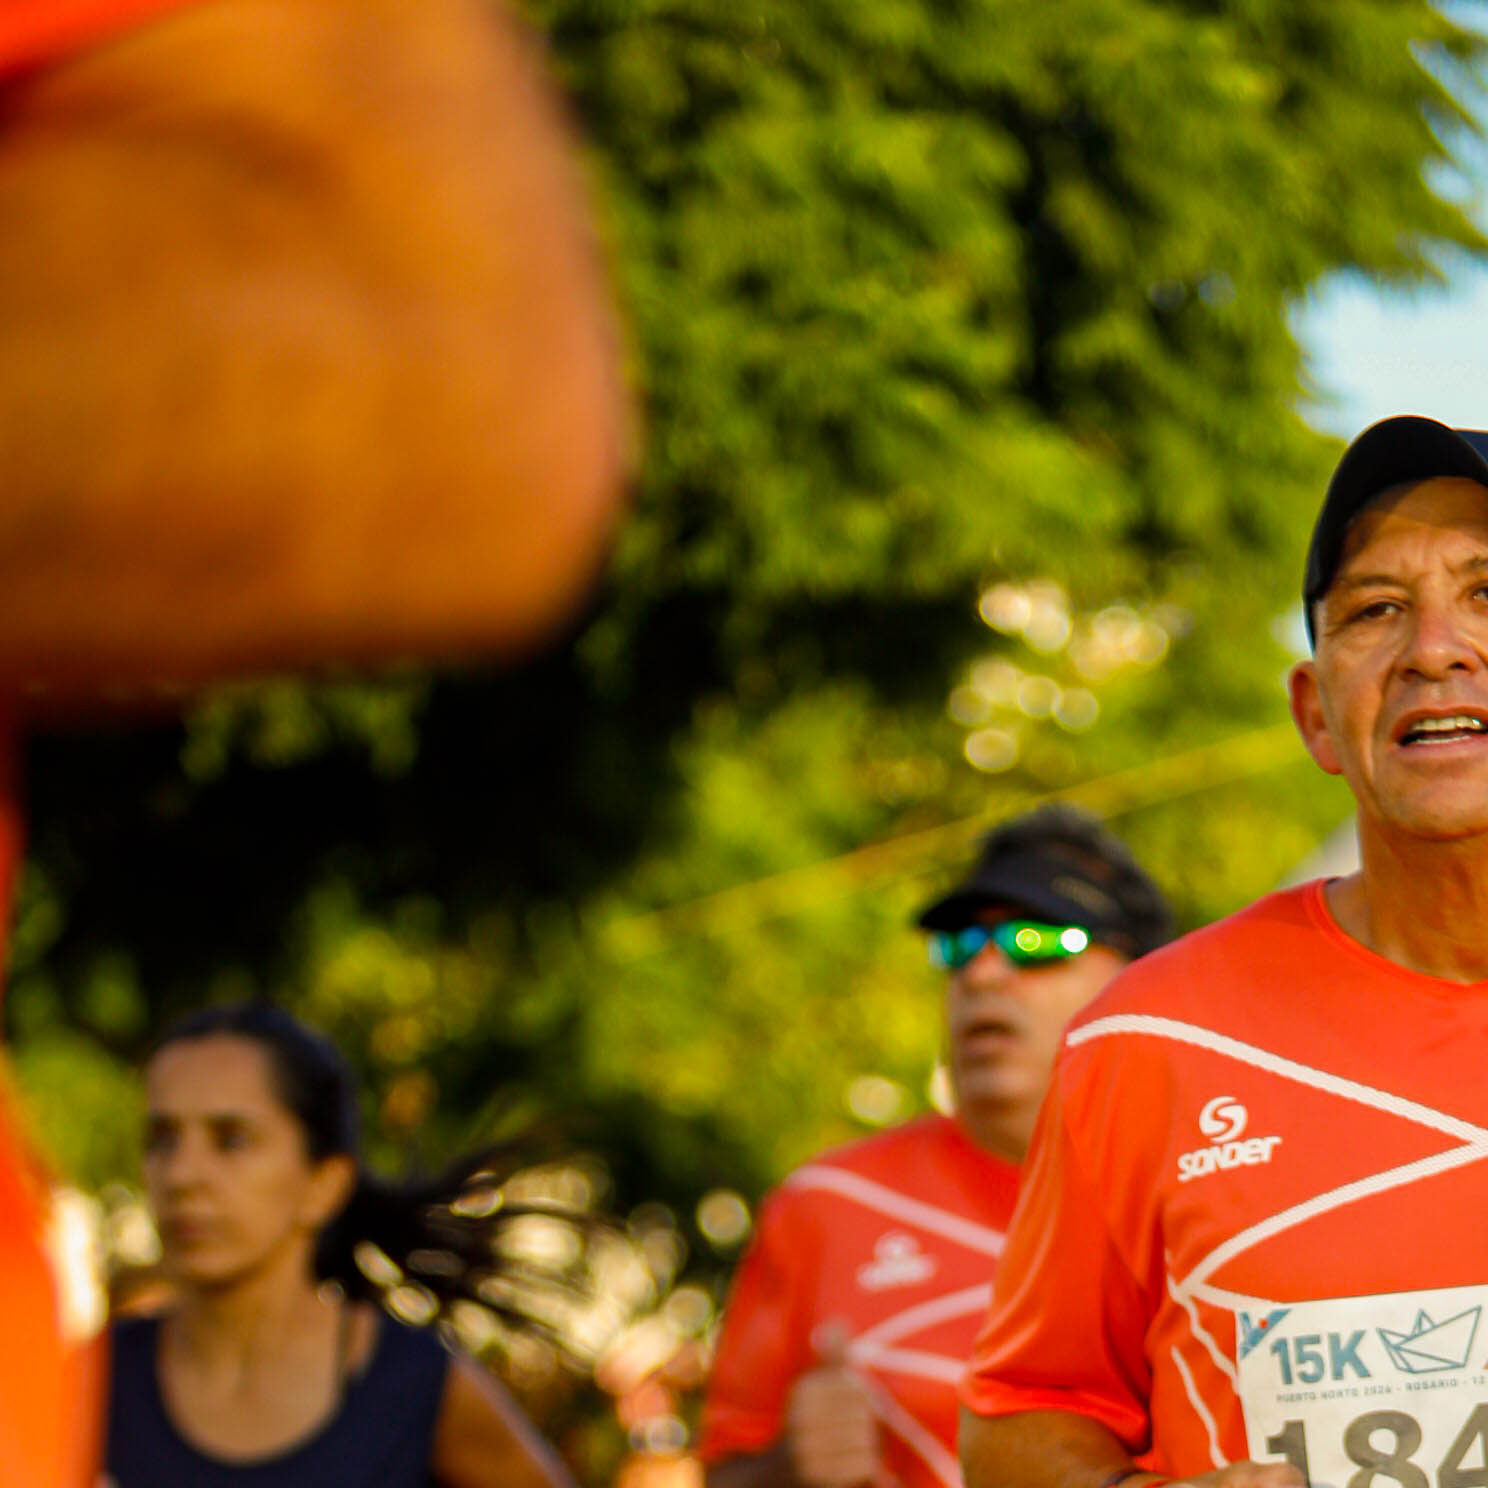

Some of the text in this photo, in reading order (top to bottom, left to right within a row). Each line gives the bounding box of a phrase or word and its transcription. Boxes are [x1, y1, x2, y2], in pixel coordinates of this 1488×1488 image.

[1270, 1329, 1371, 1385] 15K
[1275, 1390, 1317, 1403] PUERTO
[1320, 1386, 1359, 1400] NORTE
[1405, 1377, 1458, 1391] ROSARIO
